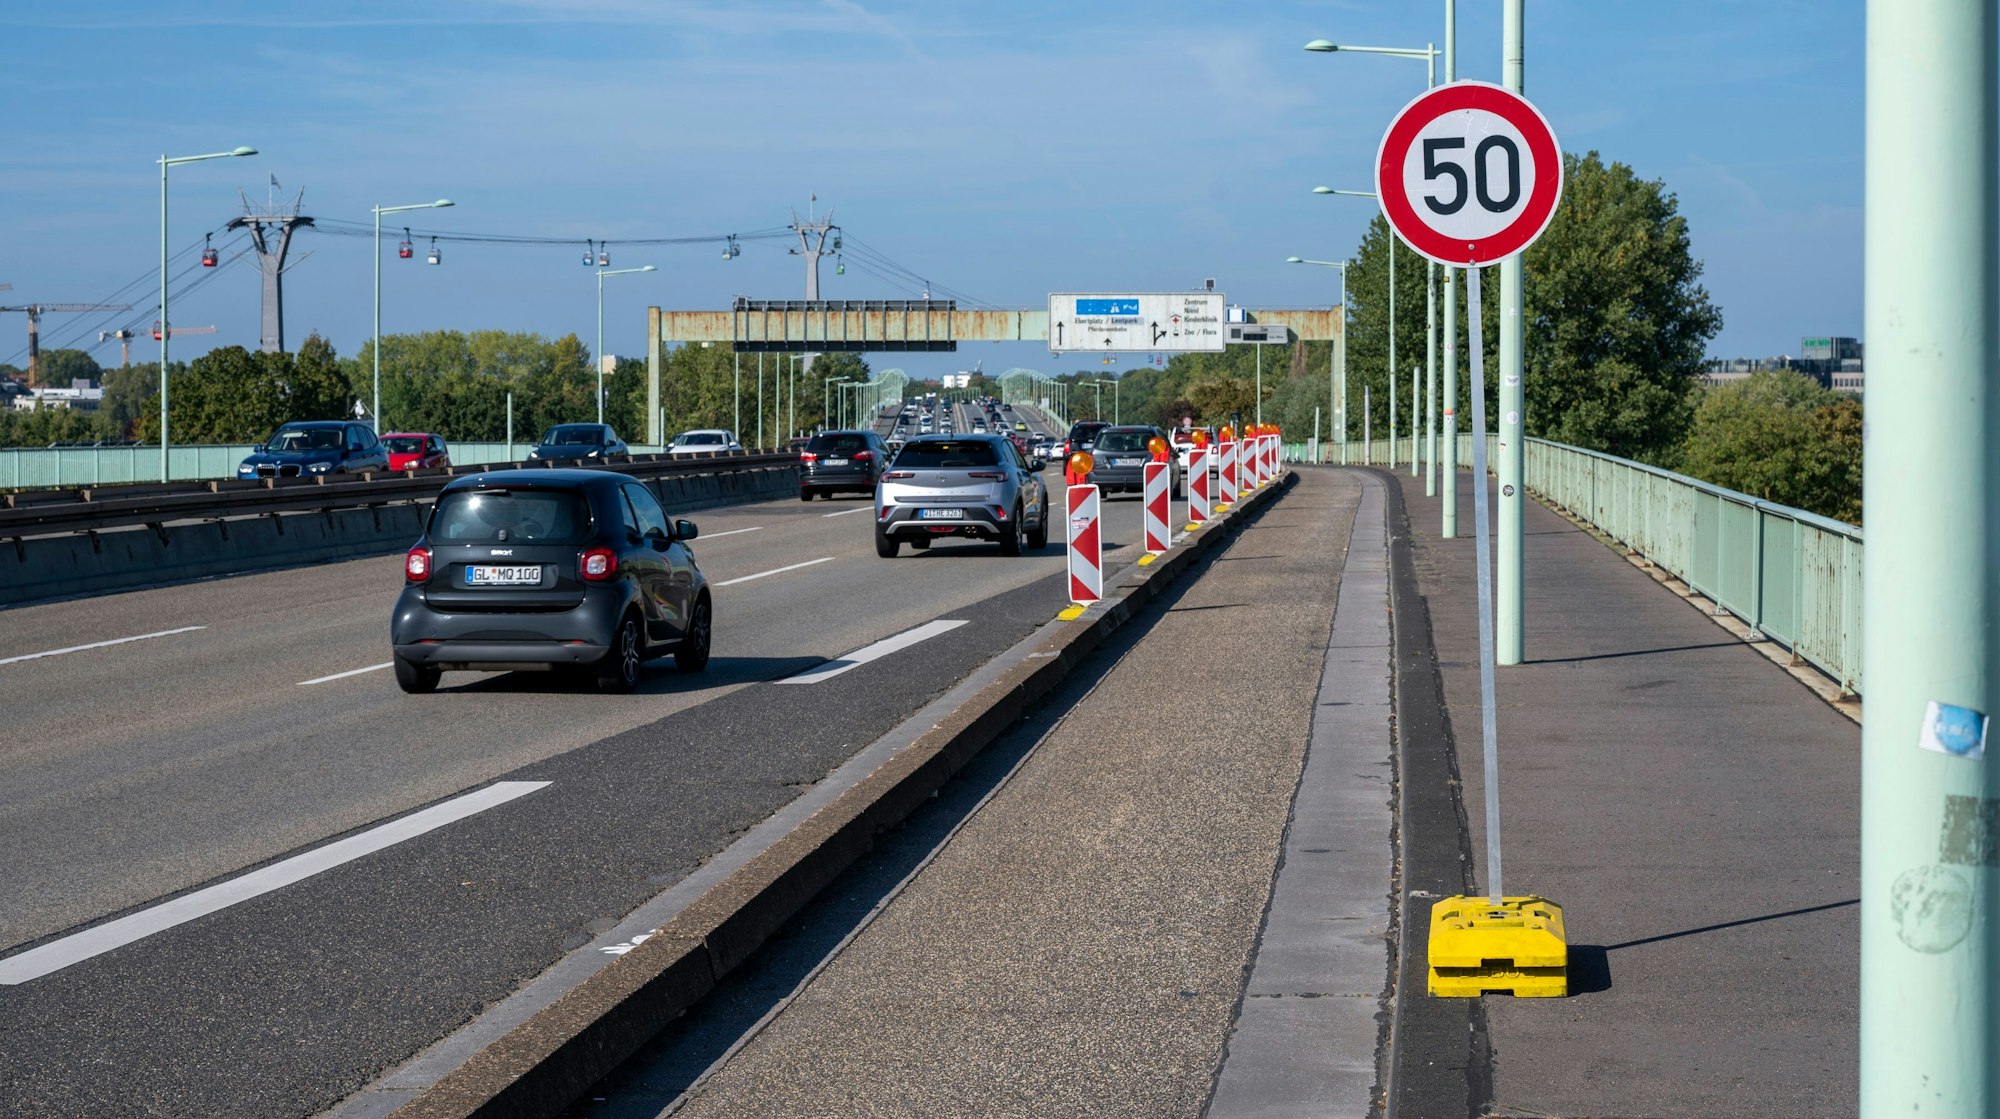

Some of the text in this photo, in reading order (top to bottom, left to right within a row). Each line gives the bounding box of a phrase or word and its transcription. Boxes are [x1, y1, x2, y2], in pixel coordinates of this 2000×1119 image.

[1423, 135, 1520, 215] 50
[474, 568, 539, 580] GL MQ 100
